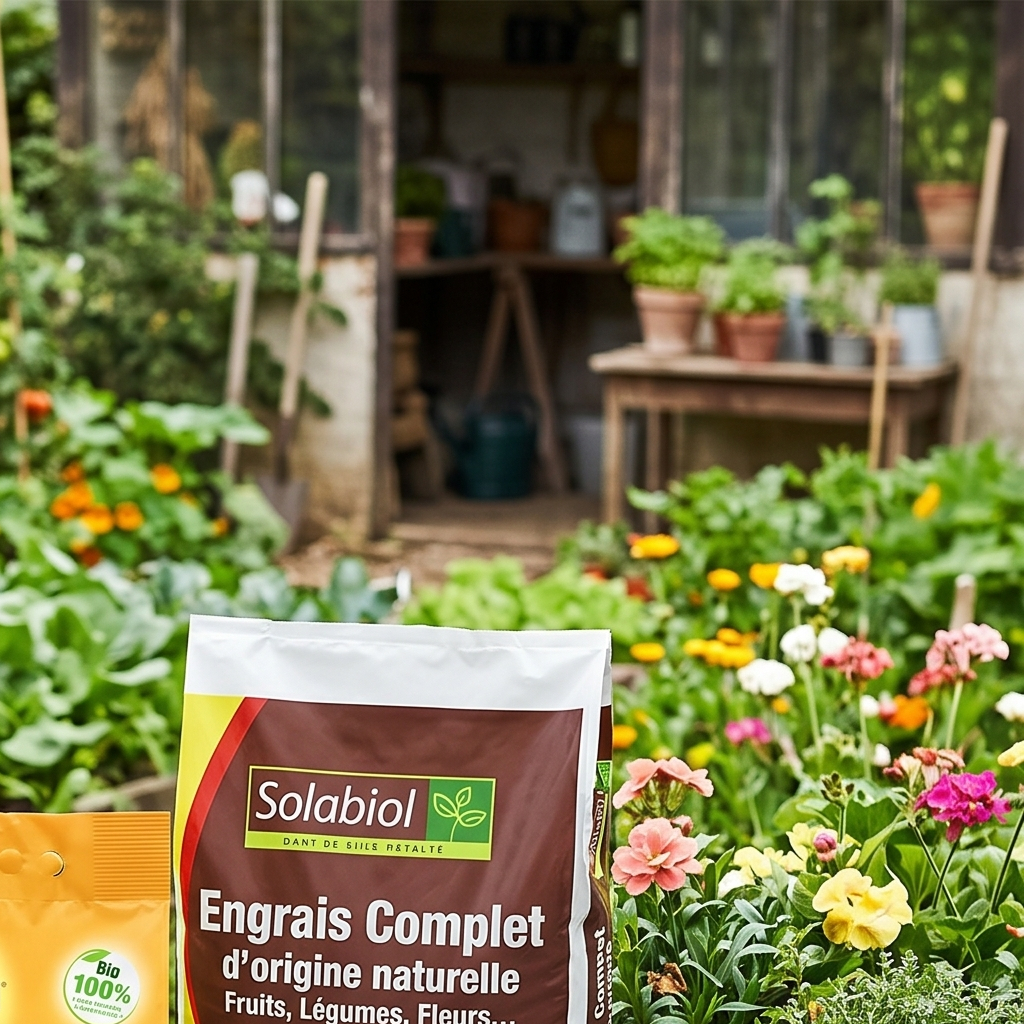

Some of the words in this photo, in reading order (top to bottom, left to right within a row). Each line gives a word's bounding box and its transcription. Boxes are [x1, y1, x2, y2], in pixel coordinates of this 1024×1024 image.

[255, 780, 417, 828] Solabiol
[323, 840, 339, 849] DE
[199, 888, 352, 945] Engrais
[365, 898, 546, 957] Complet
[96, 960, 121, 979] Bio
[372, 960, 521, 995] naturelle
[74, 973, 131, 1004] 100%
[225, 990, 292, 1023] Fruits,
